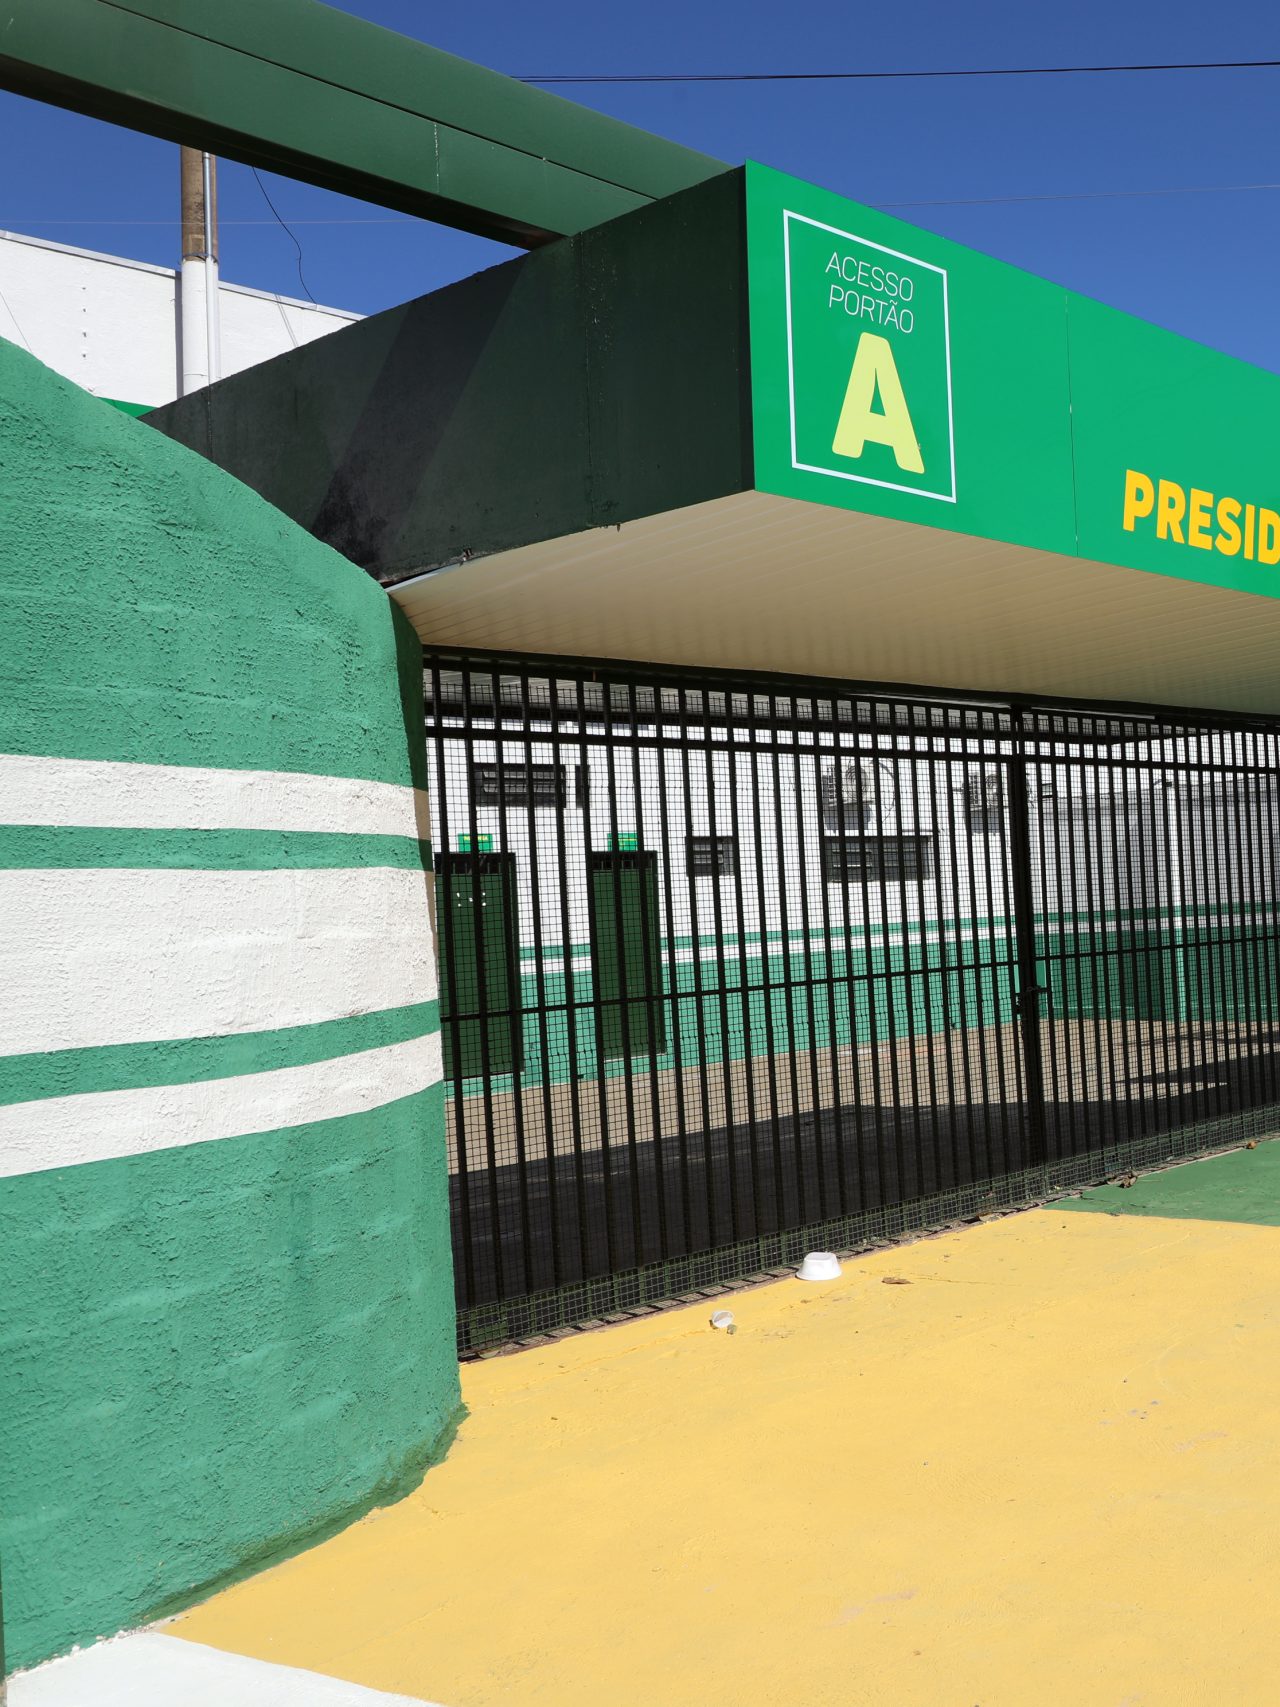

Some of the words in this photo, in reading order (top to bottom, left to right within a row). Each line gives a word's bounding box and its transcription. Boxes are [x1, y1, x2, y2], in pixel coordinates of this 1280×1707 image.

[825, 251, 914, 302] ACESSO
[828, 284, 914, 334] PORTÃO
[831, 331, 926, 475] A
